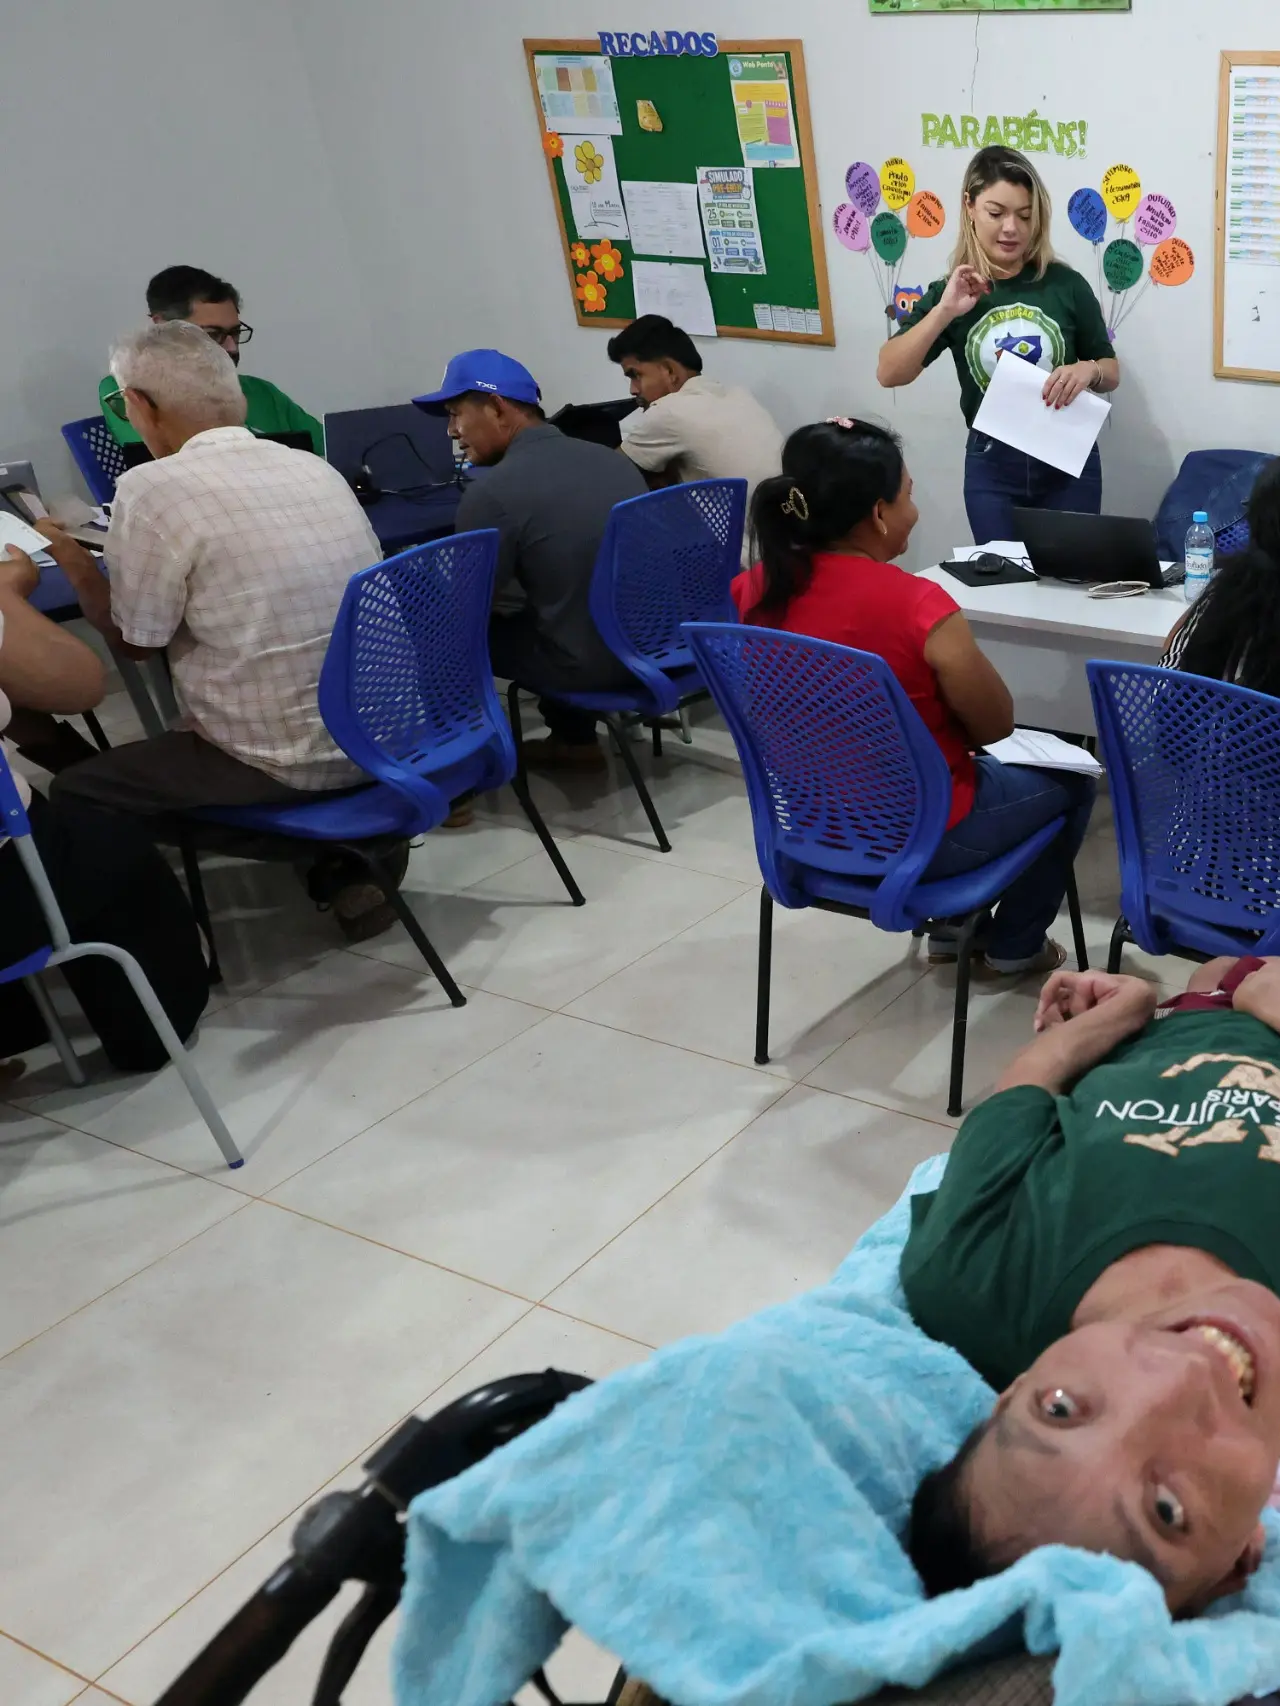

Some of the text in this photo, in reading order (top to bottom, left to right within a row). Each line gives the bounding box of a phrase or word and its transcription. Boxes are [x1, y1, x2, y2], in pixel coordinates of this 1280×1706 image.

[597, 30, 719, 57] RECADOS
[921, 109, 1088, 159] PARABÉNS!
[708, 170, 743, 183] SIMULADO
[708, 208, 717, 219] 25
[1147, 193, 1176, 218] OUTUBRO
[712, 237, 721, 247] 01
[988, 306, 1034, 324] EXPEDIÇÃO
[1095, 1099, 1261, 1126] VUITTON
